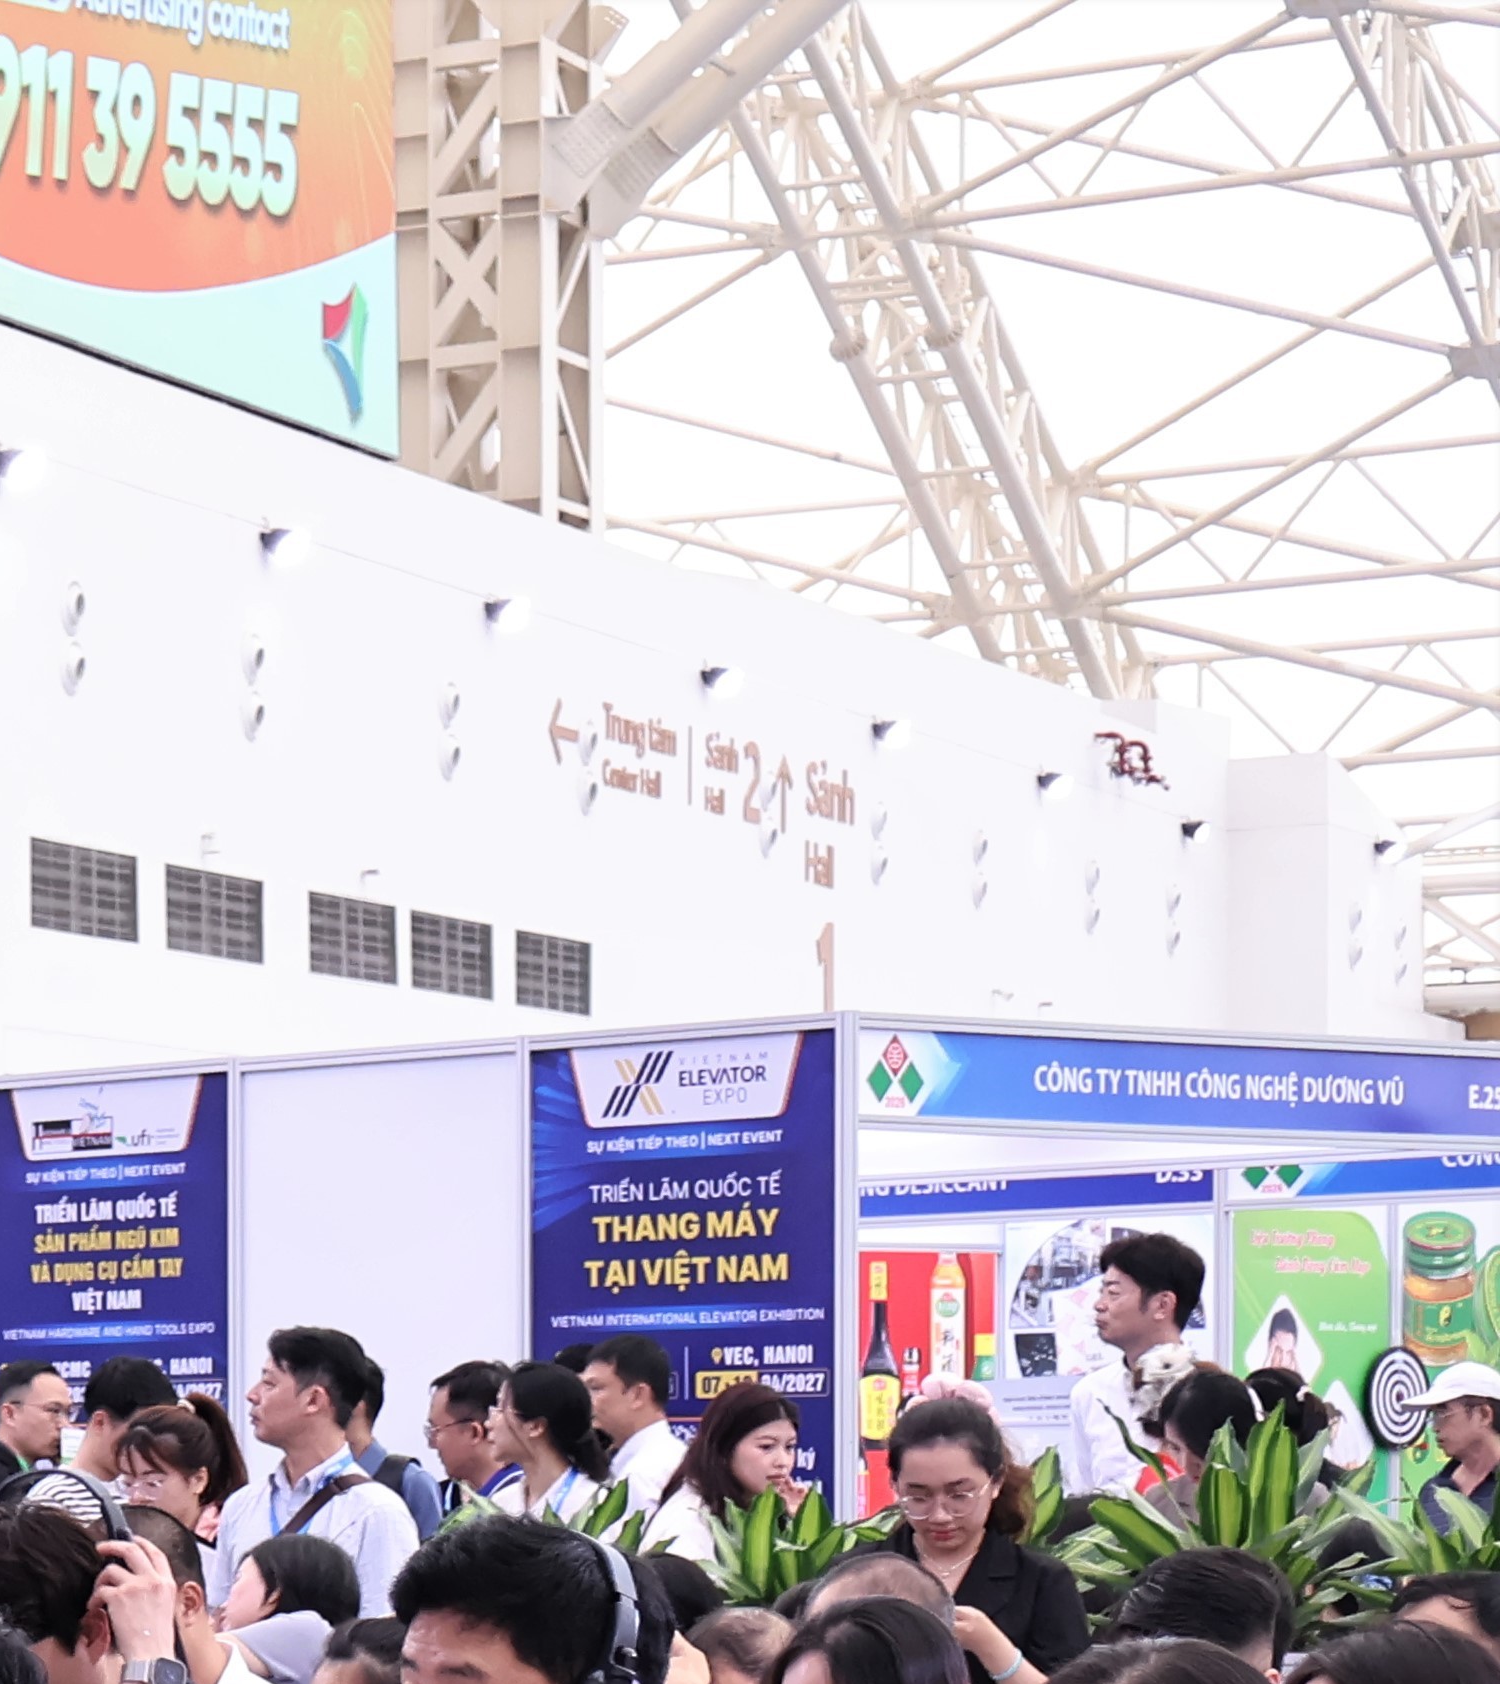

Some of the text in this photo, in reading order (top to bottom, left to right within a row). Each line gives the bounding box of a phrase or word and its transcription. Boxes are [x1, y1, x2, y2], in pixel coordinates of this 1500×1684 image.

[207, 1, 290, 49] contact
[82, 55, 157, 191] 39
[163, 72, 299, 217] 5555
[602, 702, 646, 759] Trung
[602, 759, 662, 799] Center Hall
[743, 741, 761, 825] 2
[704, 786, 725, 816] Hall
[805, 840, 834, 889] Hall
[816, 922, 835, 1012] 1
[678, 1066, 767, 1087] ELEVATOR
[702, 1087, 747, 1106] EXPO
[1034, 1060, 1092, 1093] CÔNG
[1096, 1068, 1122, 1094] TY
[1126, 1069, 1181, 1097] TNHH
[1185, 1067, 1241, 1100] CÔNG
[1245, 1071, 1298, 1107] NGHỆ
[1303, 1074, 1374, 1105] DƯƠNG
[1377, 1075, 1404, 1106] VŨ
[707, 1129, 783, 1146] NEXT EVENT
[694, 1170, 752, 1200] QUỐC
[756, 1168, 782, 1195] TẾ
[592, 1201, 780, 1243] THANG MÁY
[158, 1258, 183, 1278] TAY
[583, 1249, 789, 1294] TẠI VIỆT NAM
[106, 1289, 142, 1310] NAM
[551, 1315, 604, 1328] VIETNAM
[606, 1312, 697, 1327] INTERNATIONAL
[699, 1310, 758, 1324] ELEVATOR
[722, 1344, 814, 1368] VEC, HANOI
